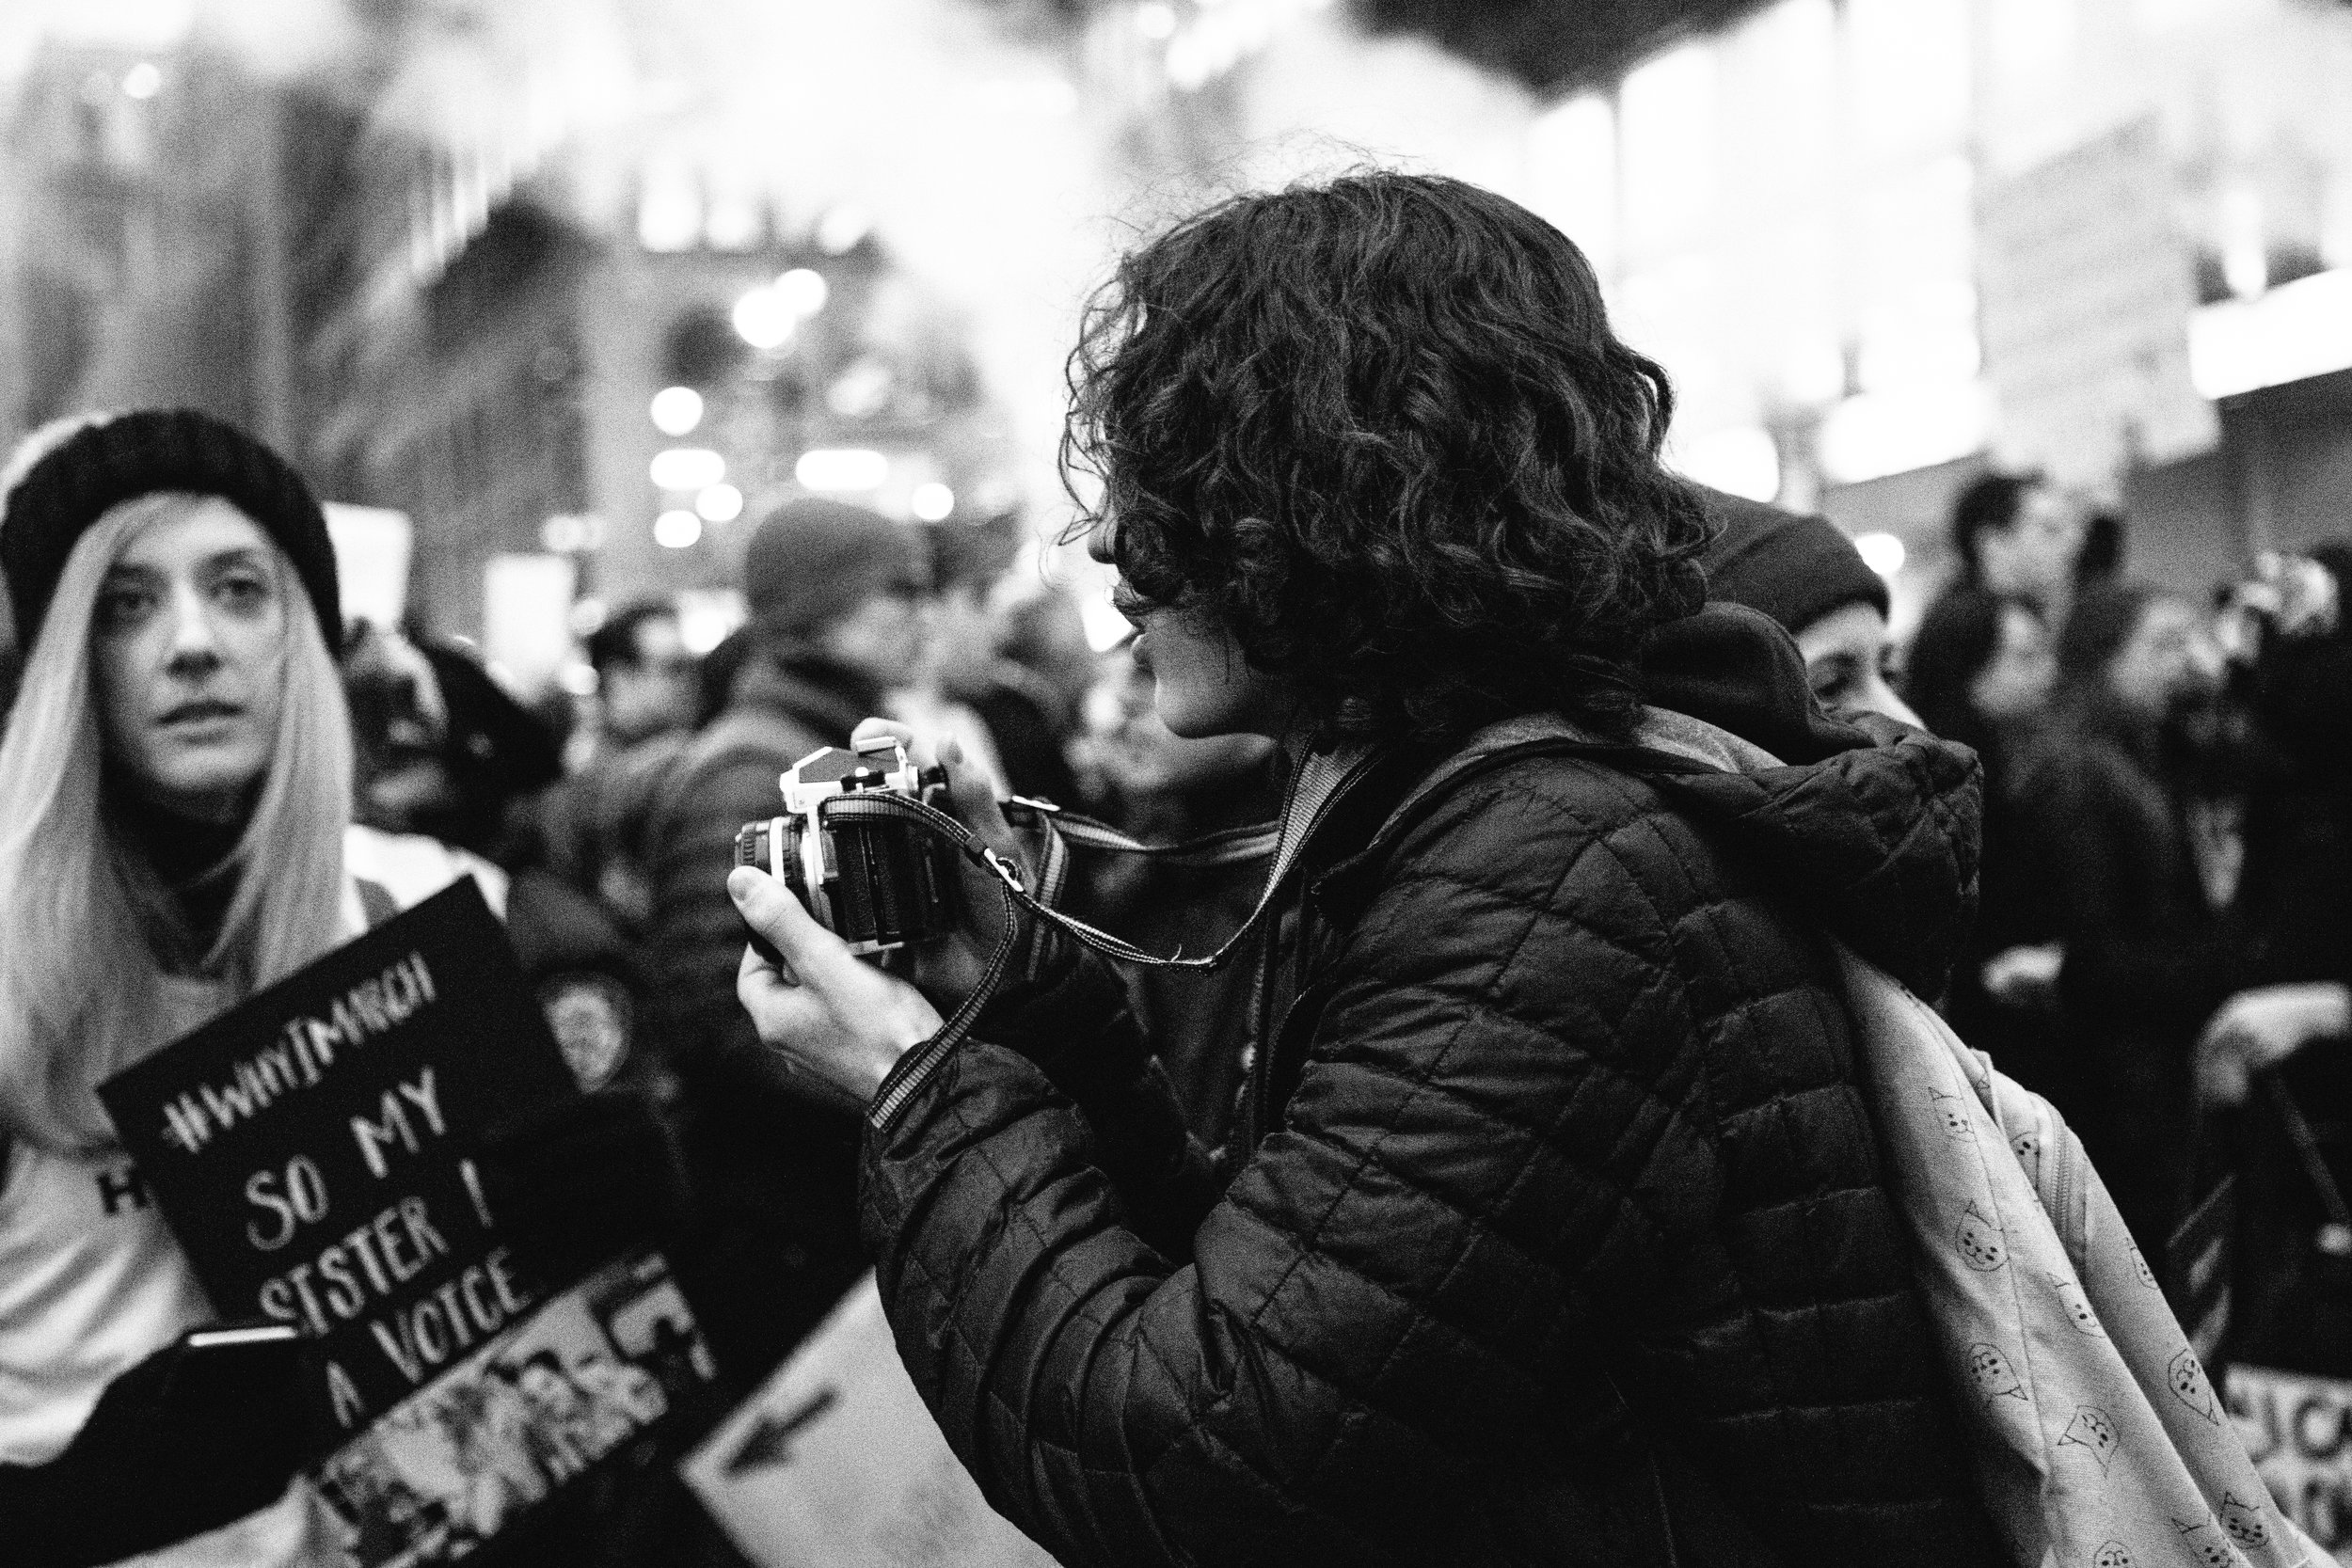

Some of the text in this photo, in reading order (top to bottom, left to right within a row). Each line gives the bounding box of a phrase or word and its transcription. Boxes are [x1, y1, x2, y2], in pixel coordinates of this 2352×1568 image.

[245, 1066, 446, 1250] SO MY
[259, 1196, 448, 1336] SISTER
[326, 1249, 532, 1427] A VOICE
